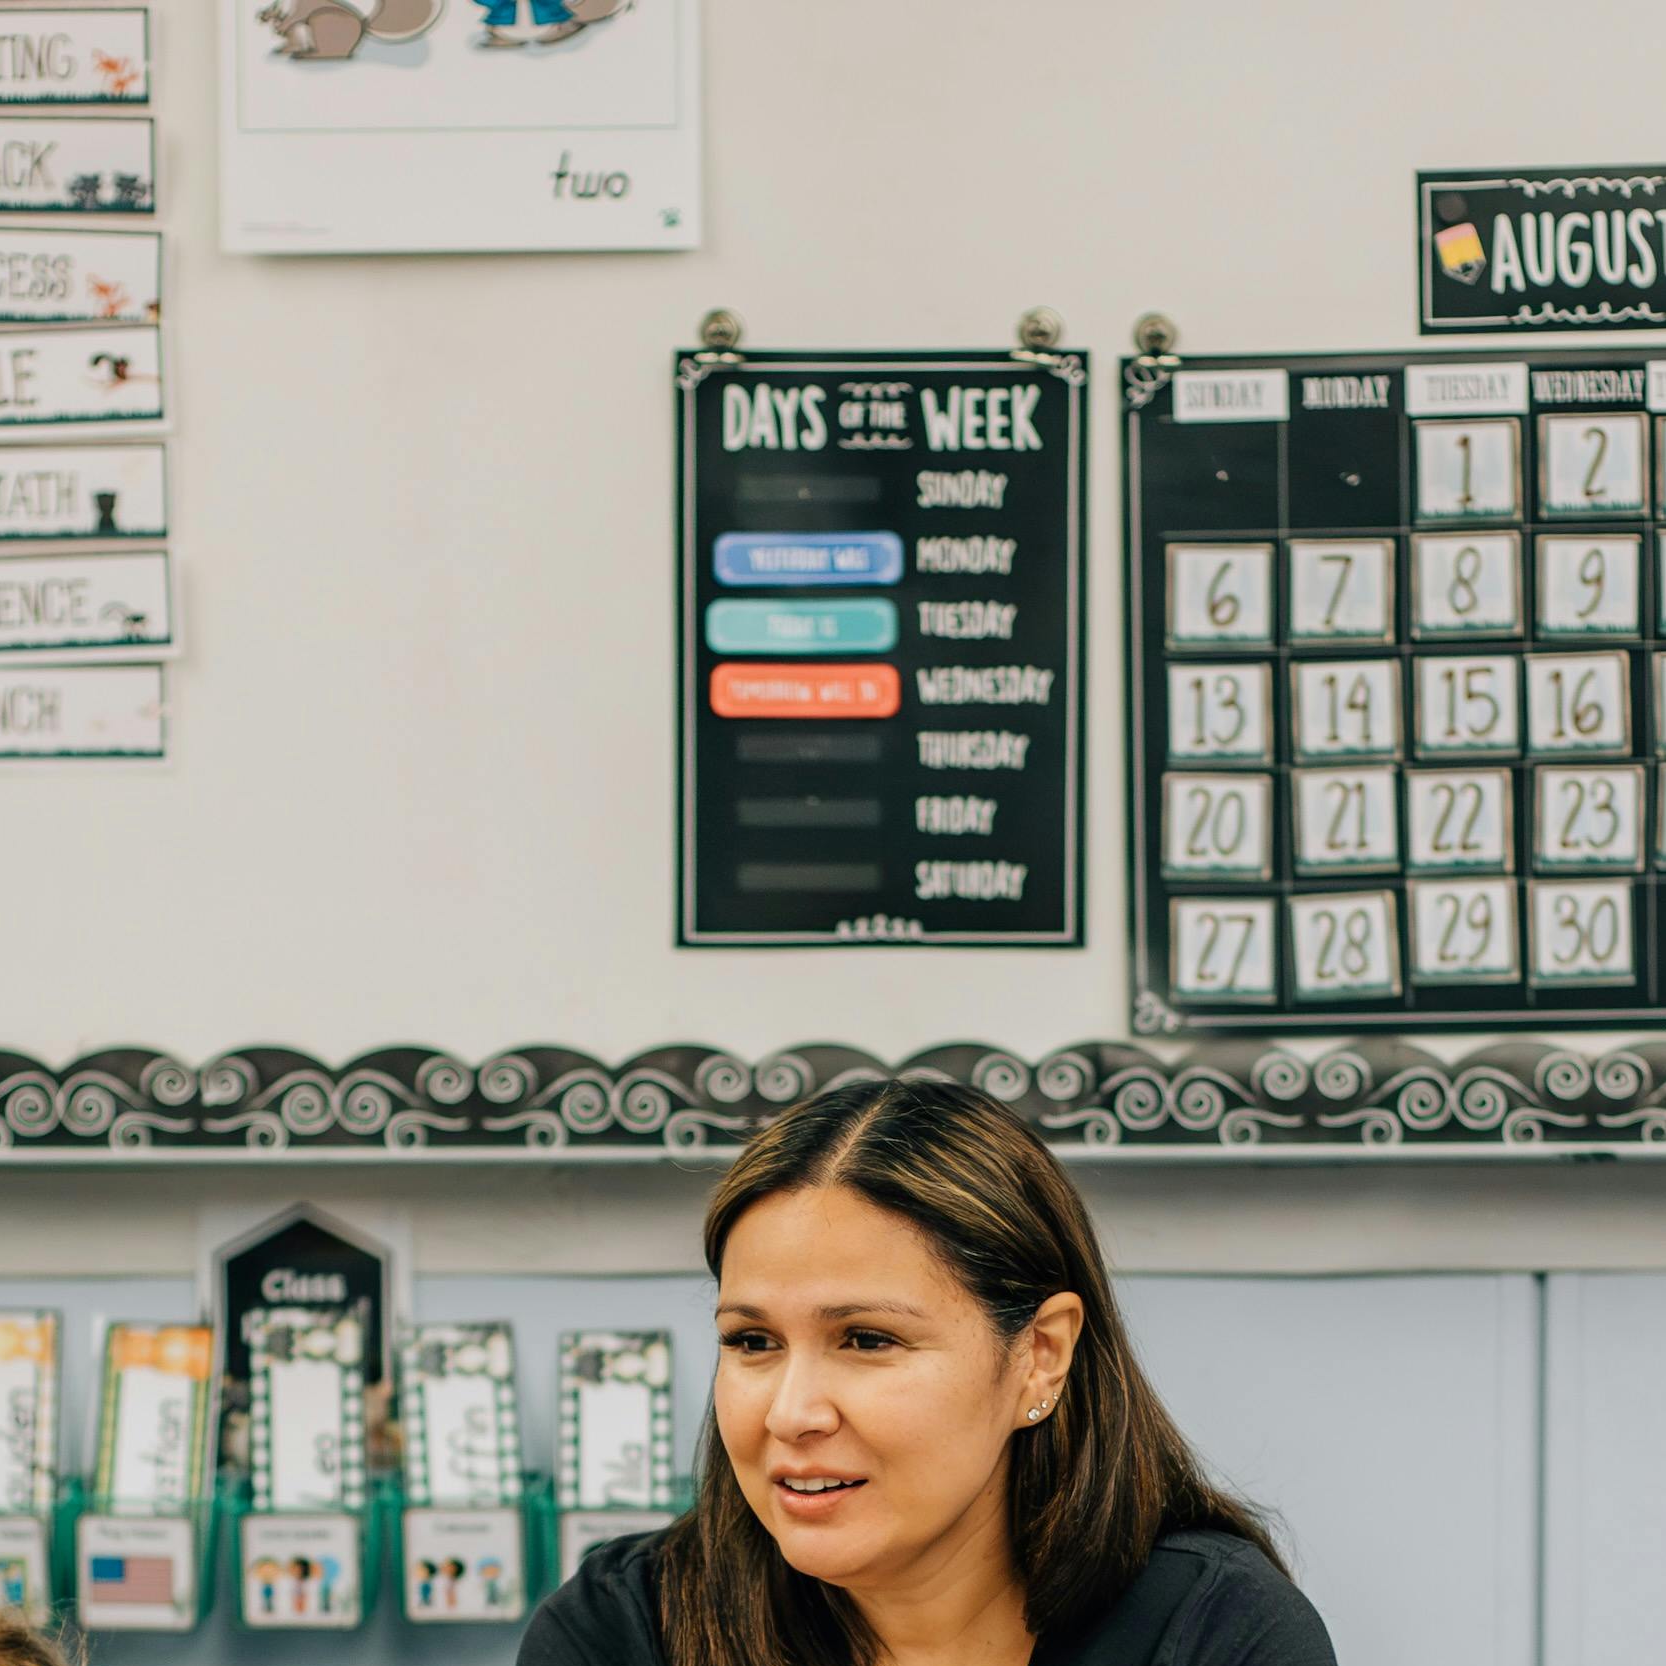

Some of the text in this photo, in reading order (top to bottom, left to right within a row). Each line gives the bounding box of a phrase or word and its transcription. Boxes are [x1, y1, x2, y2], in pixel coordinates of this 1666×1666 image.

[552, 154, 632, 199] two
[1301, 374, 1391, 411] MONDAY
[1424, 373, 1511, 403] TUESDAY
[1530, 368, 1647, 404] WEDNESDAY
[722, 383, 827, 452] DAYS
[868, 400, 907, 428] THE
[919, 384, 1043, 452] WEEK
[1457, 434, 1474, 505] 1
[1581, 427, 1609, 498] 2
[916, 470, 1008, 509] SUNDAY
[916, 535, 1017, 575] MONDAY
[1207, 560, 1241, 627] 6
[1319, 554, 1353, 626] 7
[1448, 546, 1482, 616] 8
[1577, 547, 1606, 619] 9
[917, 600, 1018, 640] TUESDAY
[916, 665, 1055, 706] WEDNESDAY
[1189, 675, 1245, 745] 13
[1322, 672, 1373, 743] 14
[1442, 667, 1499, 738] 15
[1549, 669, 1604, 738] 16
[916, 730, 1030, 770] THURSDAY
[915, 796, 997, 835] FRIDAY
[1185, 788, 1247, 857] 20
[1323, 781, 1370, 850] 21
[1431, 783, 1485, 853] 22
[1560, 779, 1620, 849] 23
[915, 860, 1028, 901] SATURDAY
[1196, 893, 1619, 986] 27 28 29 30
[261, 1268, 347, 1303] Class
